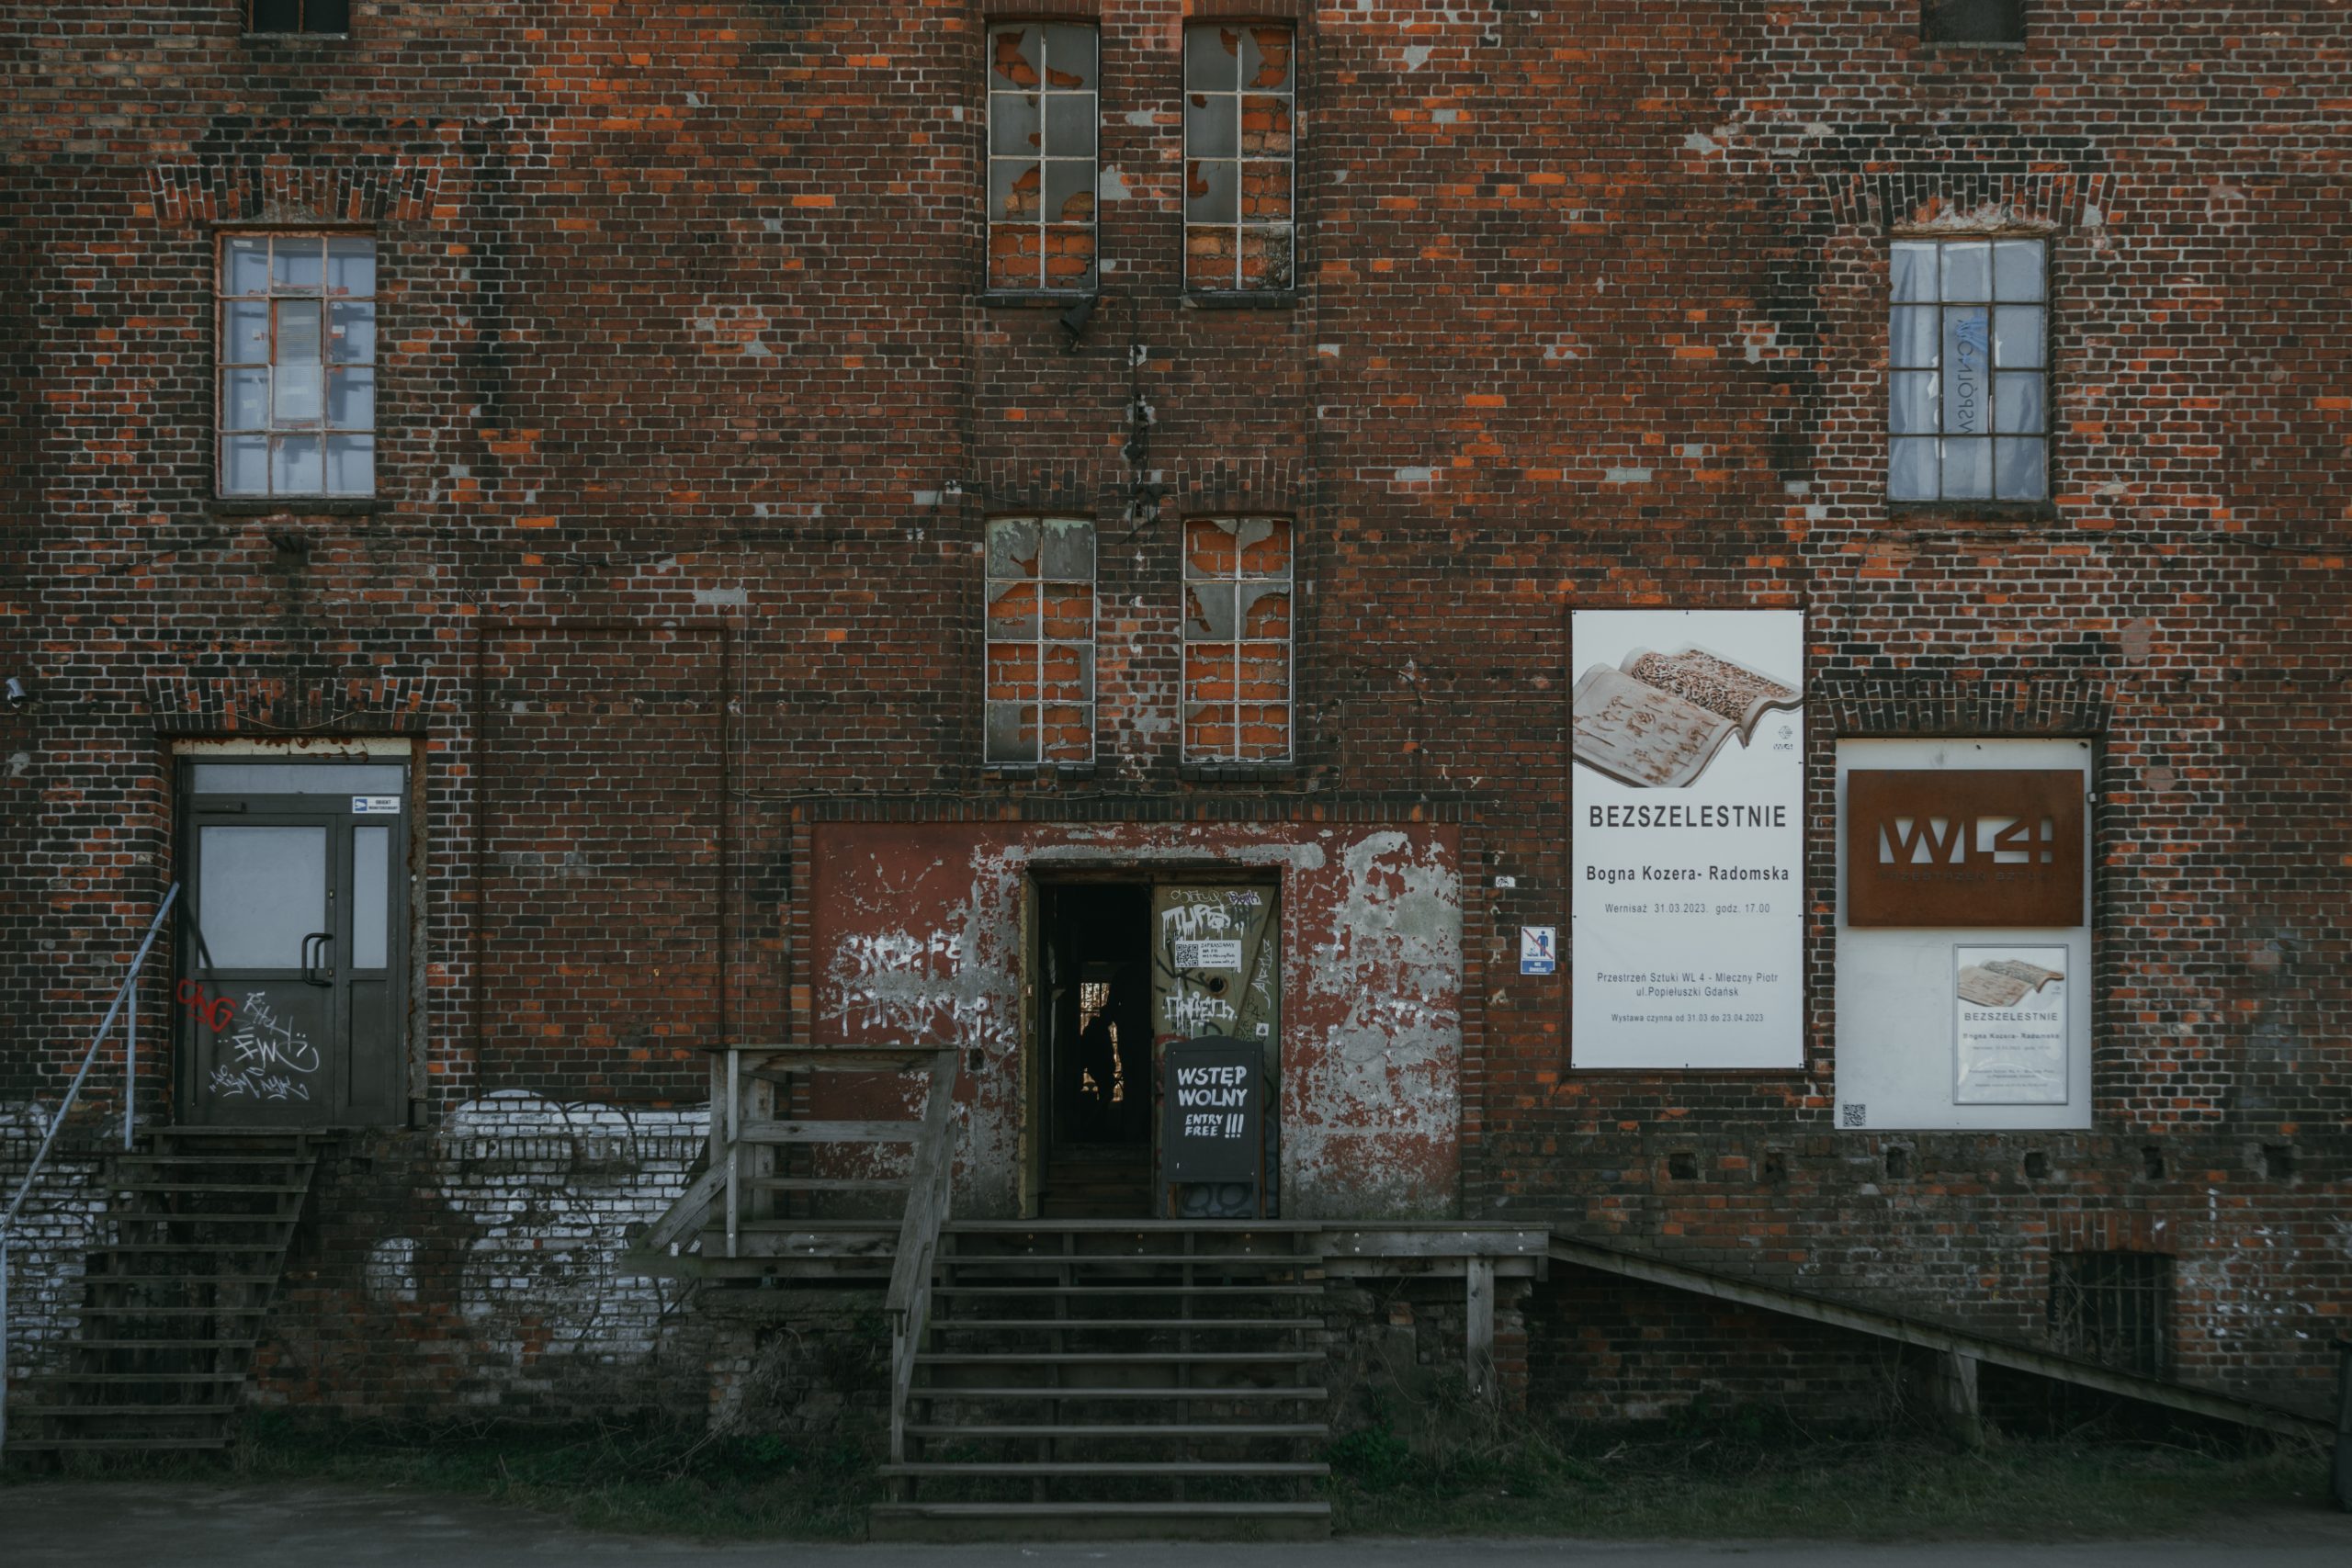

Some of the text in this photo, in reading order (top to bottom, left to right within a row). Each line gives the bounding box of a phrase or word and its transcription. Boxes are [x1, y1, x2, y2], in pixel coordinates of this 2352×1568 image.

[1589, 805, 1787, 829] BEZSZELESTNIE
[1586, 864, 1789, 885] Bogna Kozera- Radomska
[1604, 903, 1647, 914] Wernisaż
[1715, 903, 1741, 916] godz.
[1745, 903, 1770, 914] 17.00
[1597, 972, 1647, 983] Przestrzeń
[1649, 972, 1679, 983] Sztuki
[1682, 972, 1697, 983] WL
[1699, 973, 1705, 983] 4
[1714, 972, 1753, 985] Mleczny
[1756, 972, 1779, 983] Piotr
[1703, 986, 1739, 998] Gdańsk
[1611, 1013, 1764, 1024] Wystawa czynna od 31.03 do 23.04.2023
[1963, 1012, 2058, 1021] BEZSZELESTNIE
[1177, 1066, 1247, 1087] WSTĘP
[1178, 1089, 1248, 1107] WOLNY
[1184, 1113, 1224, 1125] ENTRY
[1184, 1125, 1219, 1137] FREE
